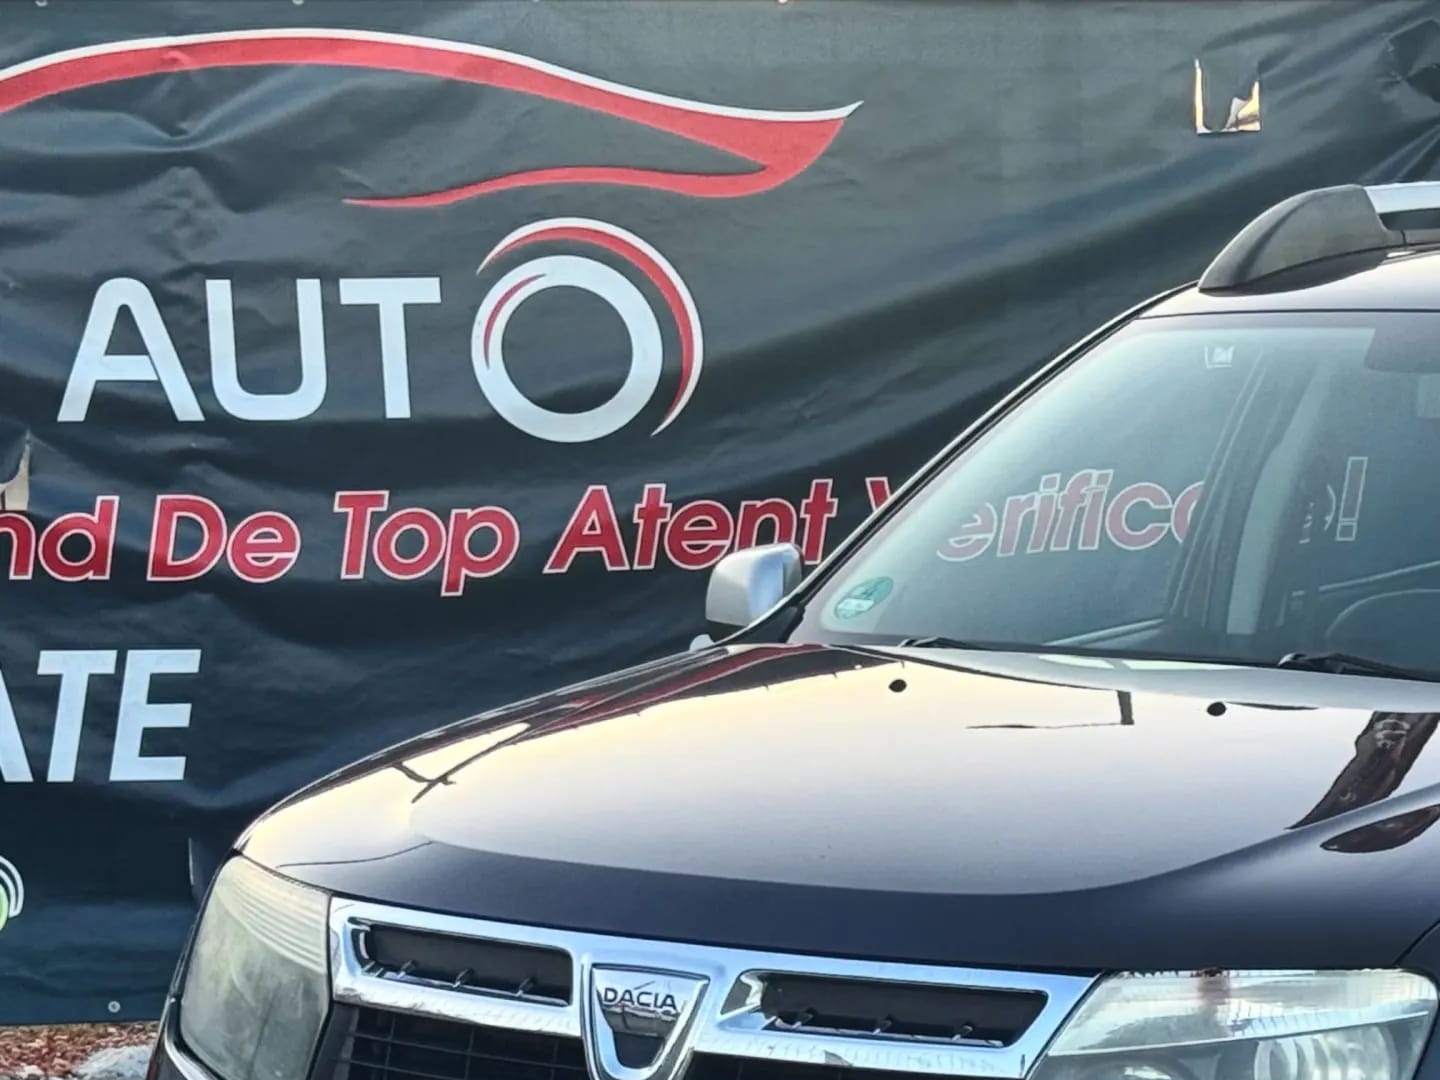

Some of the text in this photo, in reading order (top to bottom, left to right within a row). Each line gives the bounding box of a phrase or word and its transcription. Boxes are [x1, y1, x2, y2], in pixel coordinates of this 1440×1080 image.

[57, 255, 663, 443] AUTO
[147, 494, 301, 582] De
[333, 489, 520, 596] Top
[543, 478, 838, 575] Atent
[603, 987, 678, 1012] DACIA
